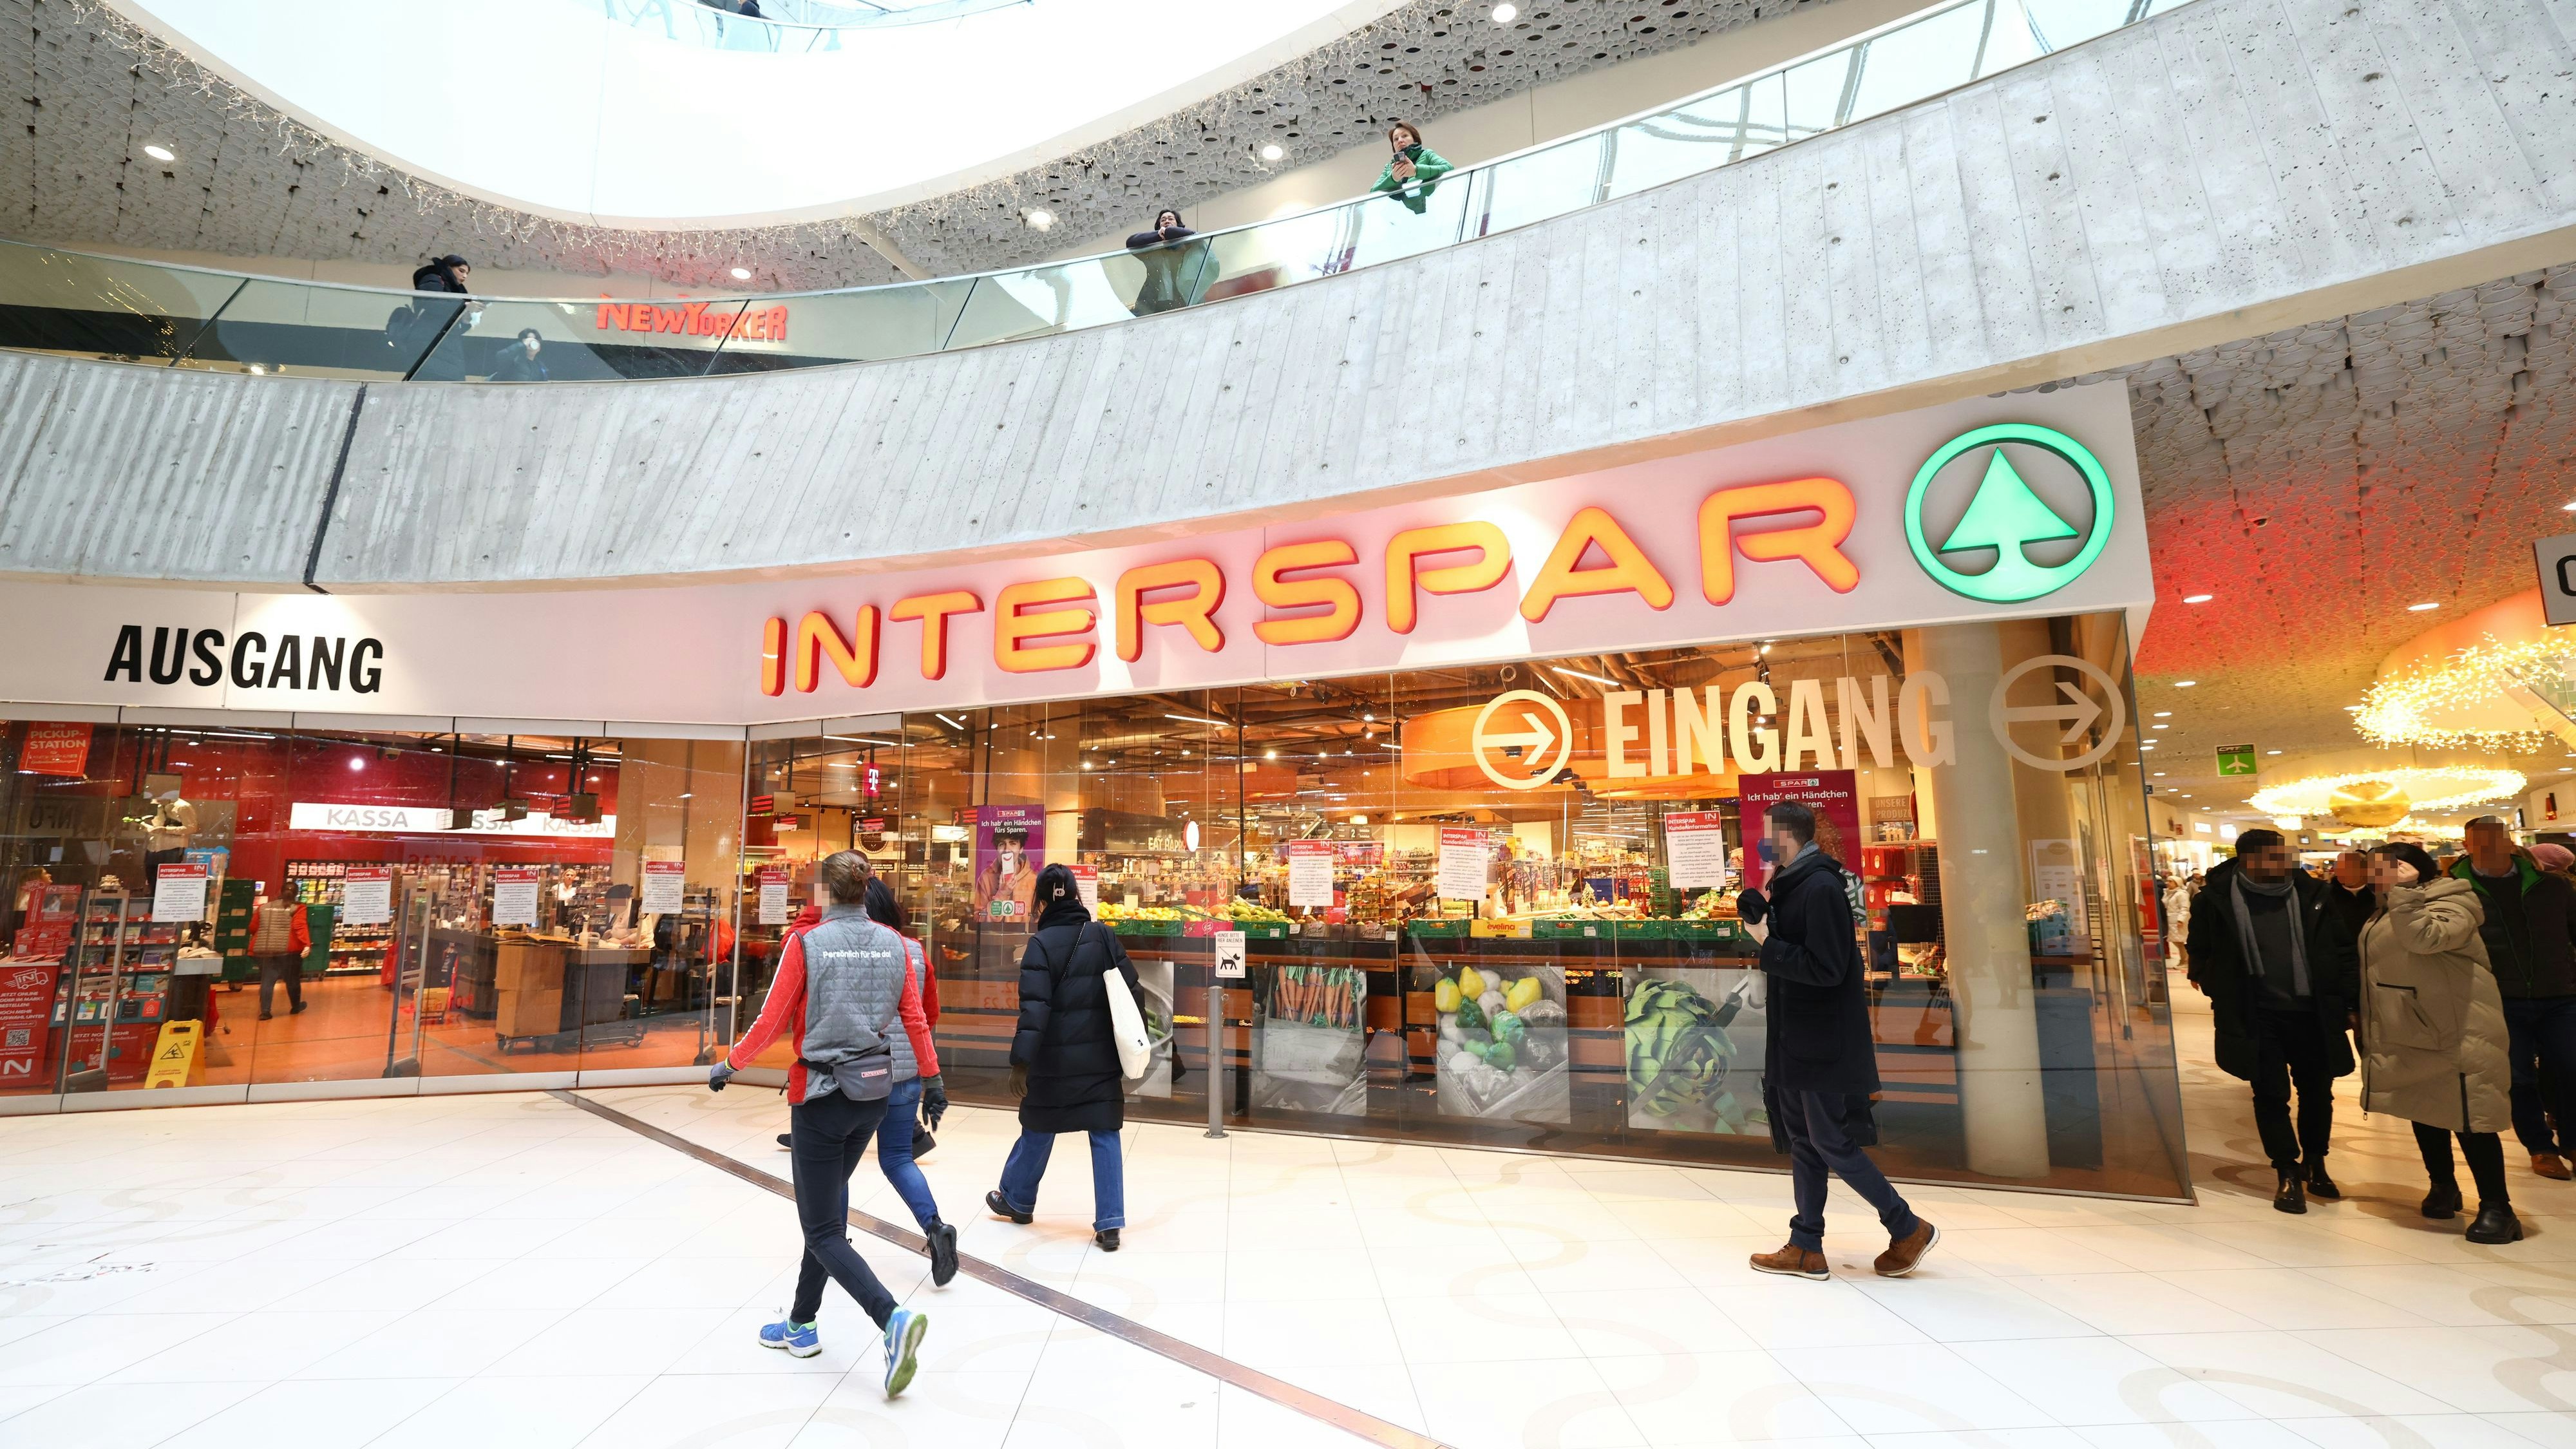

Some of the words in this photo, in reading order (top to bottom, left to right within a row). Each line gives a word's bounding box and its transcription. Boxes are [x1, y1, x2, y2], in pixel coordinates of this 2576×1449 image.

[761, 475, 1861, 697] INTERSPAR
[104, 624, 384, 694] AUSGANG
[1607, 670, 1956, 779] EINGANG
[31, 730, 85, 739] PICKUP-
[30, 740, 86, 750] STATION
[869, 768, 879, 790] T
[1747, 793, 1760, 801] Ich
[1786, 791, 1799, 800] ein
[1802, 790, 1848, 800] Händchen
[1875, 799, 1906, 808] UNSERE
[327, 808, 408, 828] KASSA
[1278, 826, 1282, 835] 1
[1350, 829, 1356, 838] 2
[822, 950, 860, 959] Persönlich
[860, 950, 869, 958] für
[881, 950, 891, 958] da!
[18, 974, 35, 983] IN
